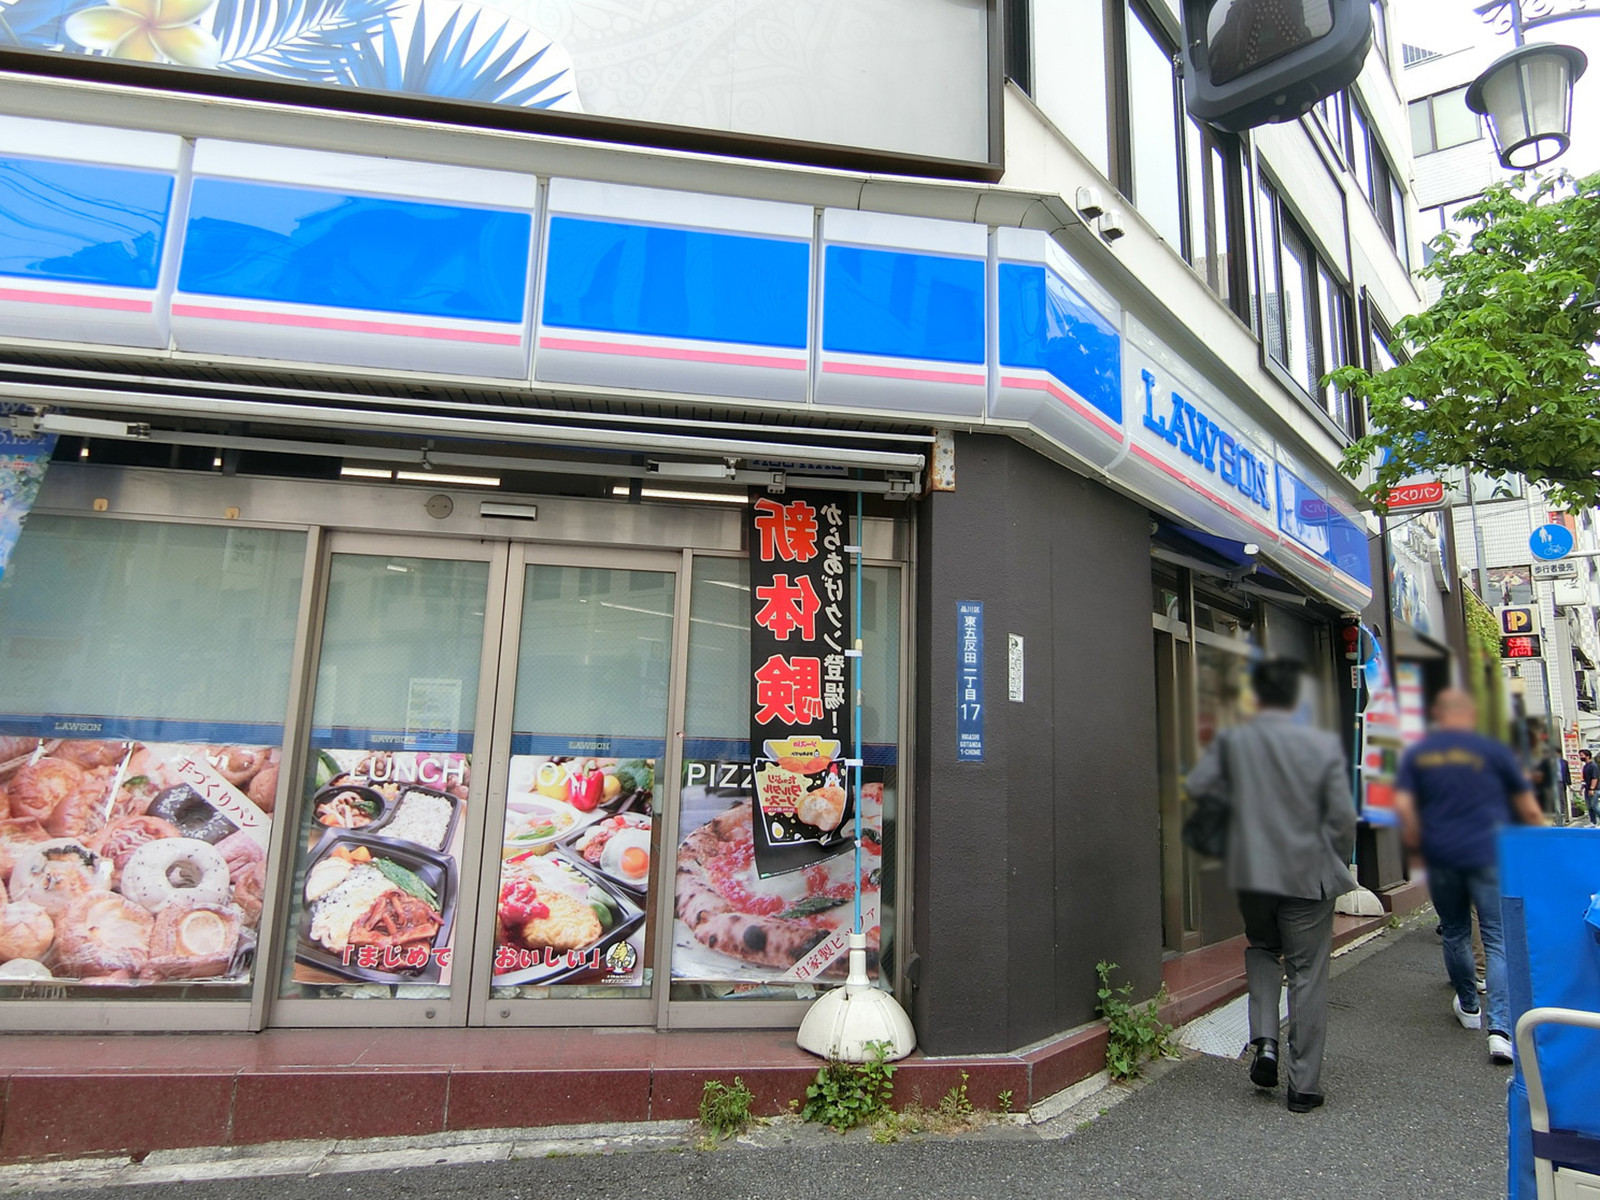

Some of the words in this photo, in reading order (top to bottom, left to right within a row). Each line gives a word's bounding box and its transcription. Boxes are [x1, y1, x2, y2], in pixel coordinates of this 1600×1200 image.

[1141, 368, 1271, 511] LAWSON
[1383, 487, 1440, 503] づくりパン
[1534, 562, 1575, 575] 歩行者優先
[963, 615, 978, 701] 東五反田一丁目
[960, 703, 981, 721] 17
[54, 721, 103, 732] LAWSON
[568, 741, 611, 751] LAWSON
[349, 753, 465, 785] LUNCH
[176, 757, 259, 829] 手づくりパン
[341, 944, 452, 968] 「まじめで
[495, 945, 601, 969] おいしい」
